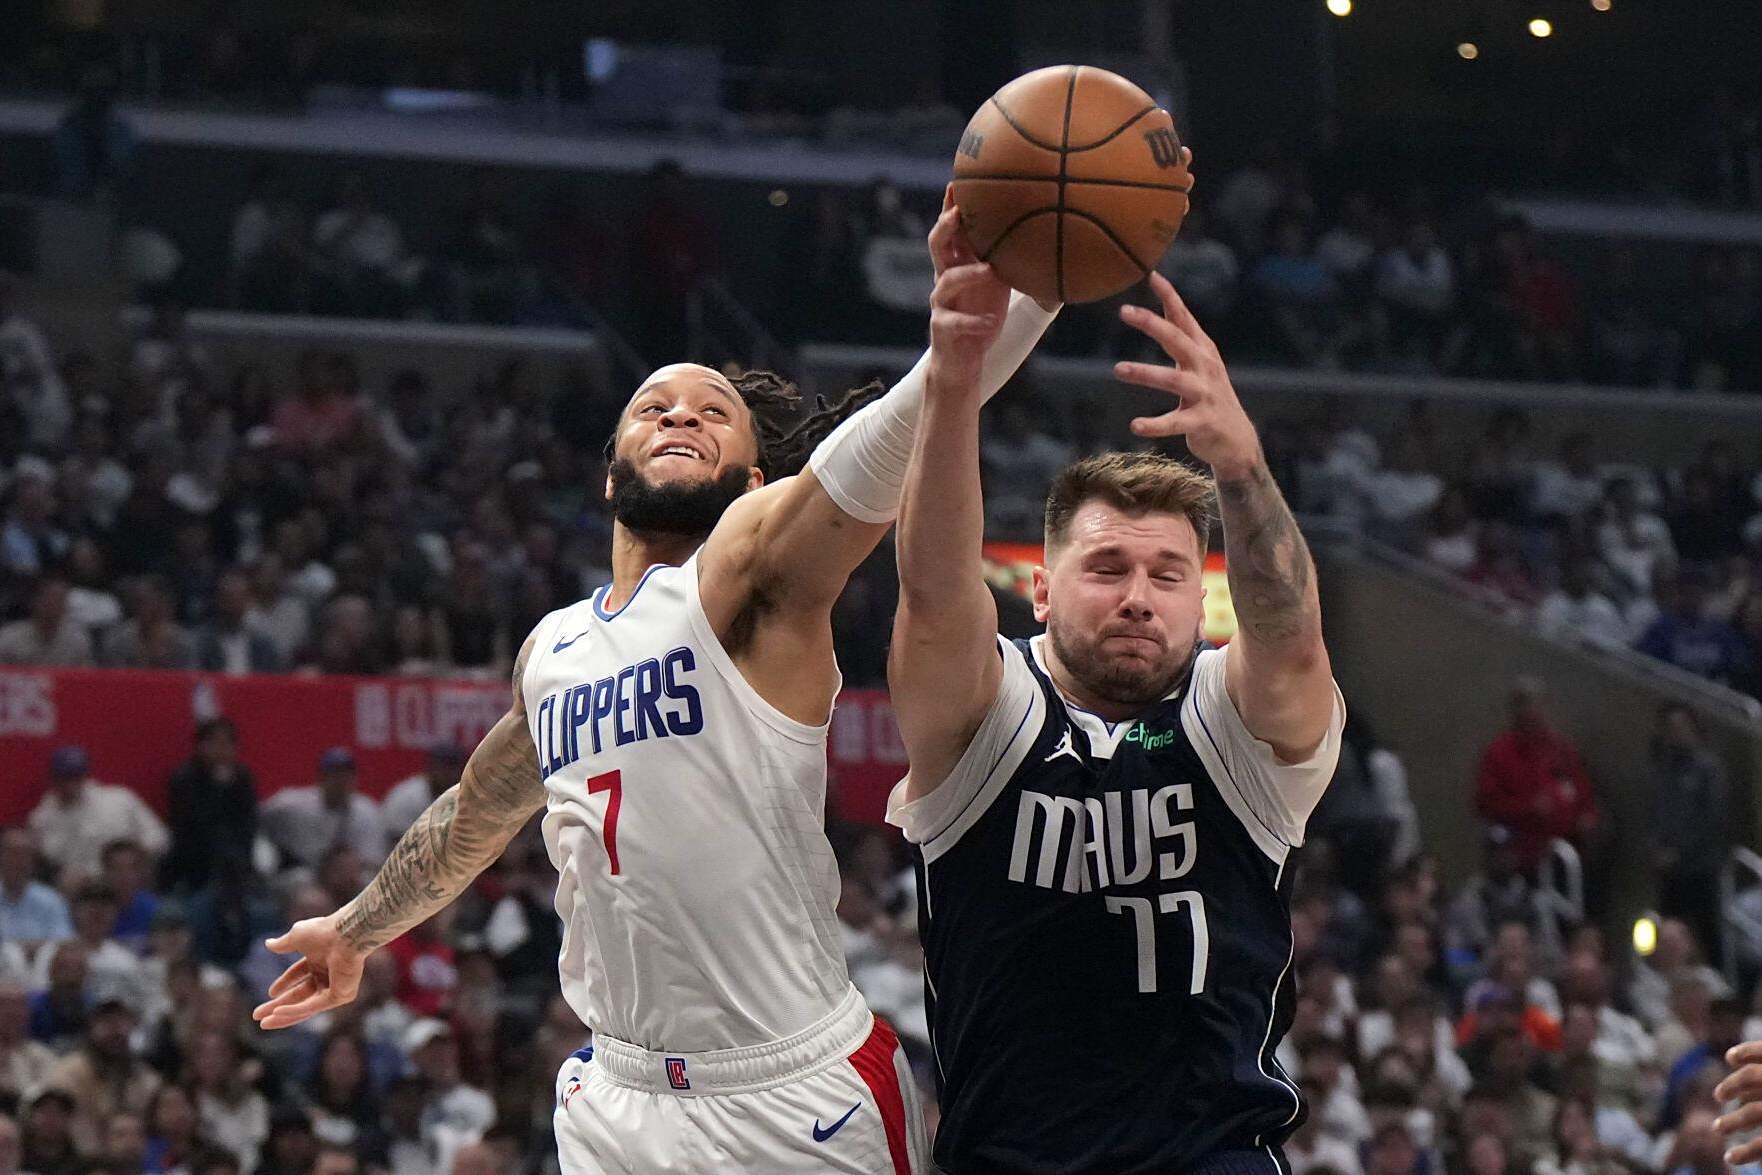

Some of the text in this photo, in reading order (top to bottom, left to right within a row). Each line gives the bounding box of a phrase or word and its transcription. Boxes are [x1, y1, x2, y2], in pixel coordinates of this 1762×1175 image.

[538, 646, 704, 784] CLIPPERS
[1125, 722, 1174, 751] chime
[587, 769, 622, 875] 7
[1104, 890, 1209, 995] 77
